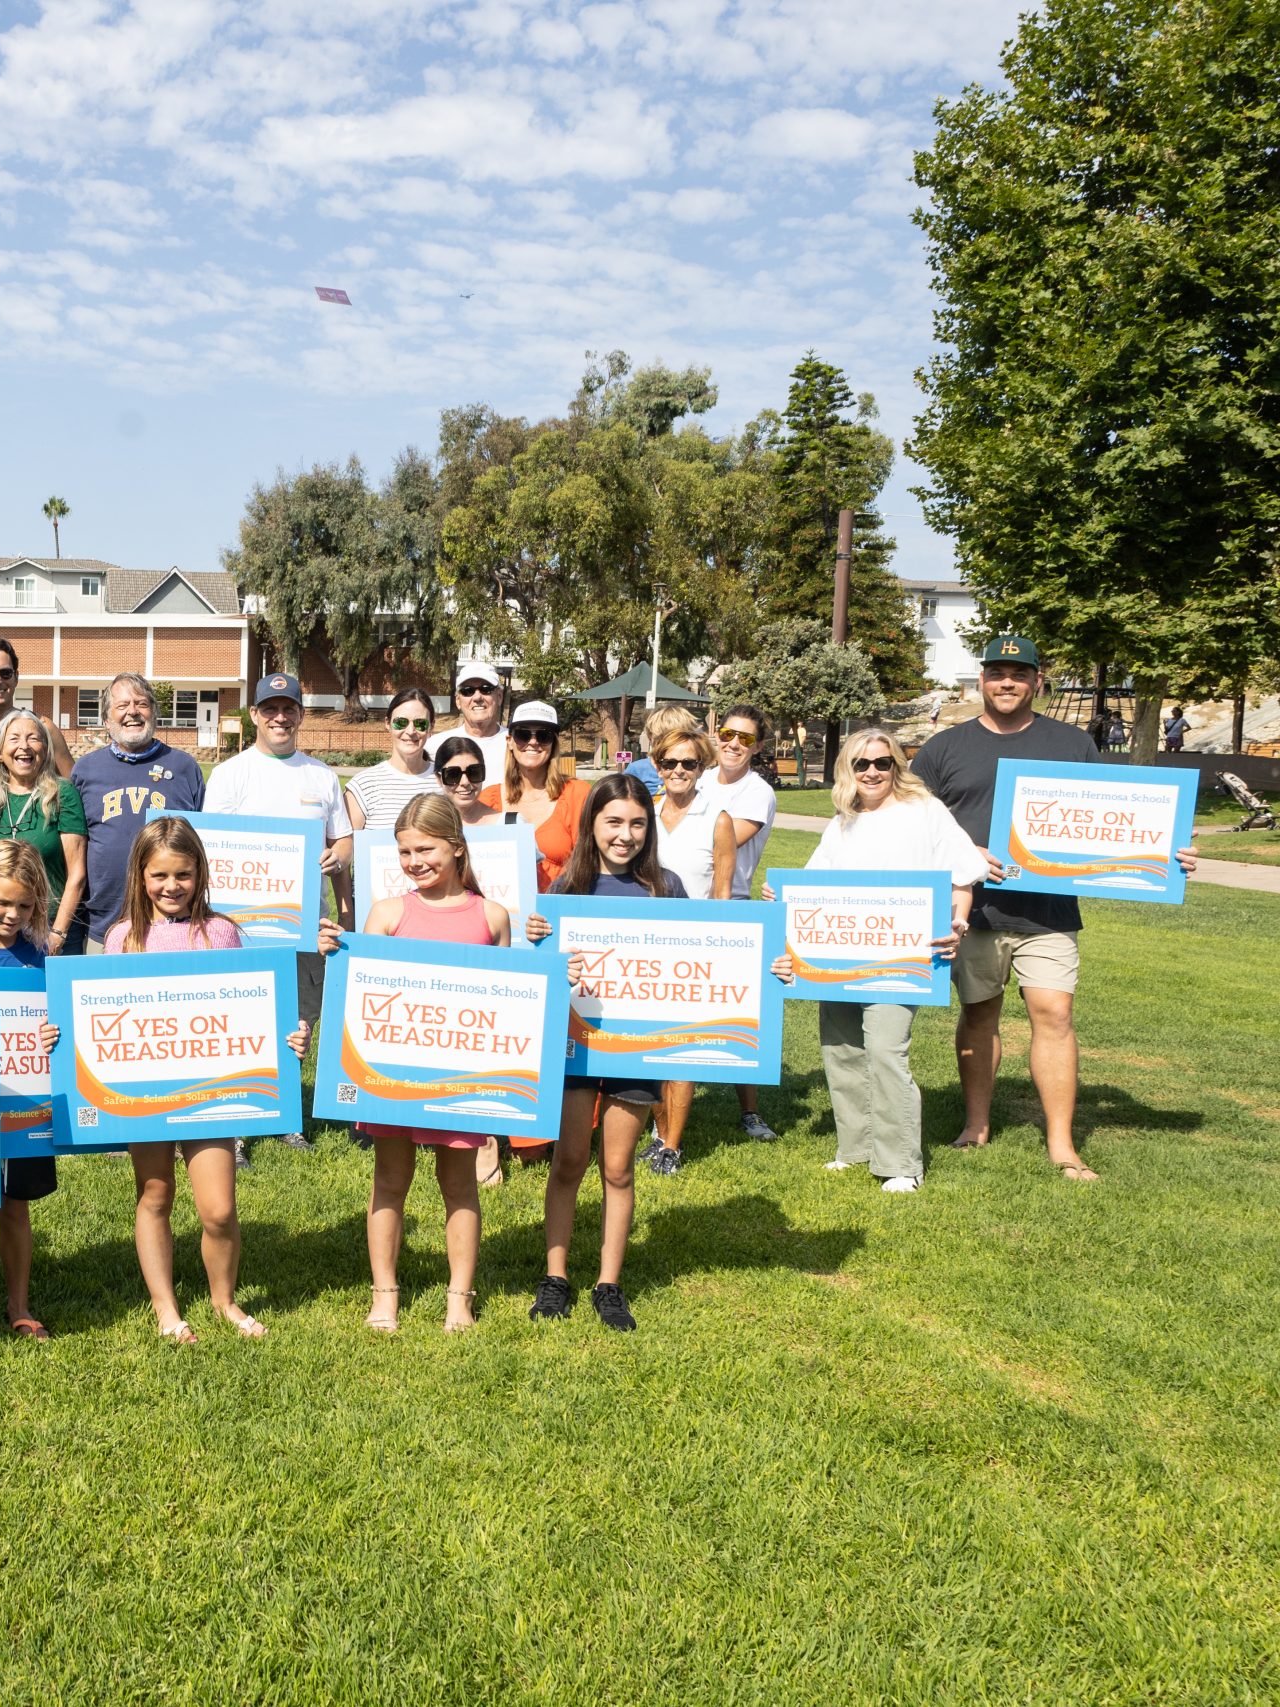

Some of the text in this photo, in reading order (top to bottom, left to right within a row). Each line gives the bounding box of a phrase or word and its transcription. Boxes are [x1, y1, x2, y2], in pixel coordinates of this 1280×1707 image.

[1021, 786, 1171, 804] Strengthen Hermosa Schools
[101, 786, 166, 823] HVS
[1058, 808, 1135, 826] YES ON
[1026, 822, 1163, 845] MEASURE HV
[221, 841, 262, 851] Hermosa
[264, 843, 299, 853] Schools
[241, 861, 270, 875] ON
[266, 878, 295, 893] HV
[824, 915, 894, 929] YES ON
[567, 931, 754, 948] Strengthen Hermosa Schools
[797, 930, 923, 947] MEASURE HV
[617, 959, 712, 980] YES ON
[355, 972, 538, 1000] Strengthen Hermosa Schools
[578, 980, 749, 1004] MEASURE HV
[81, 986, 268, 1006] Strengthen Hermosa Schools
[403, 1003, 497, 1029] YES ON
[133, 1015, 228, 1037] YES ON
[0, 1033, 36, 1051] YES
[364, 1023, 531, 1055] MEASURE HV
[582, 1030, 727, 1046] Safety Science Solar Sports
[96, 1036, 265, 1062] MEASURE HV
[365, 1076, 507, 1097] Safety Science Solar Sports
[103, 1090, 247, 1106] Safety Science Solar Sports
[10, 1110, 39, 1118] Science
